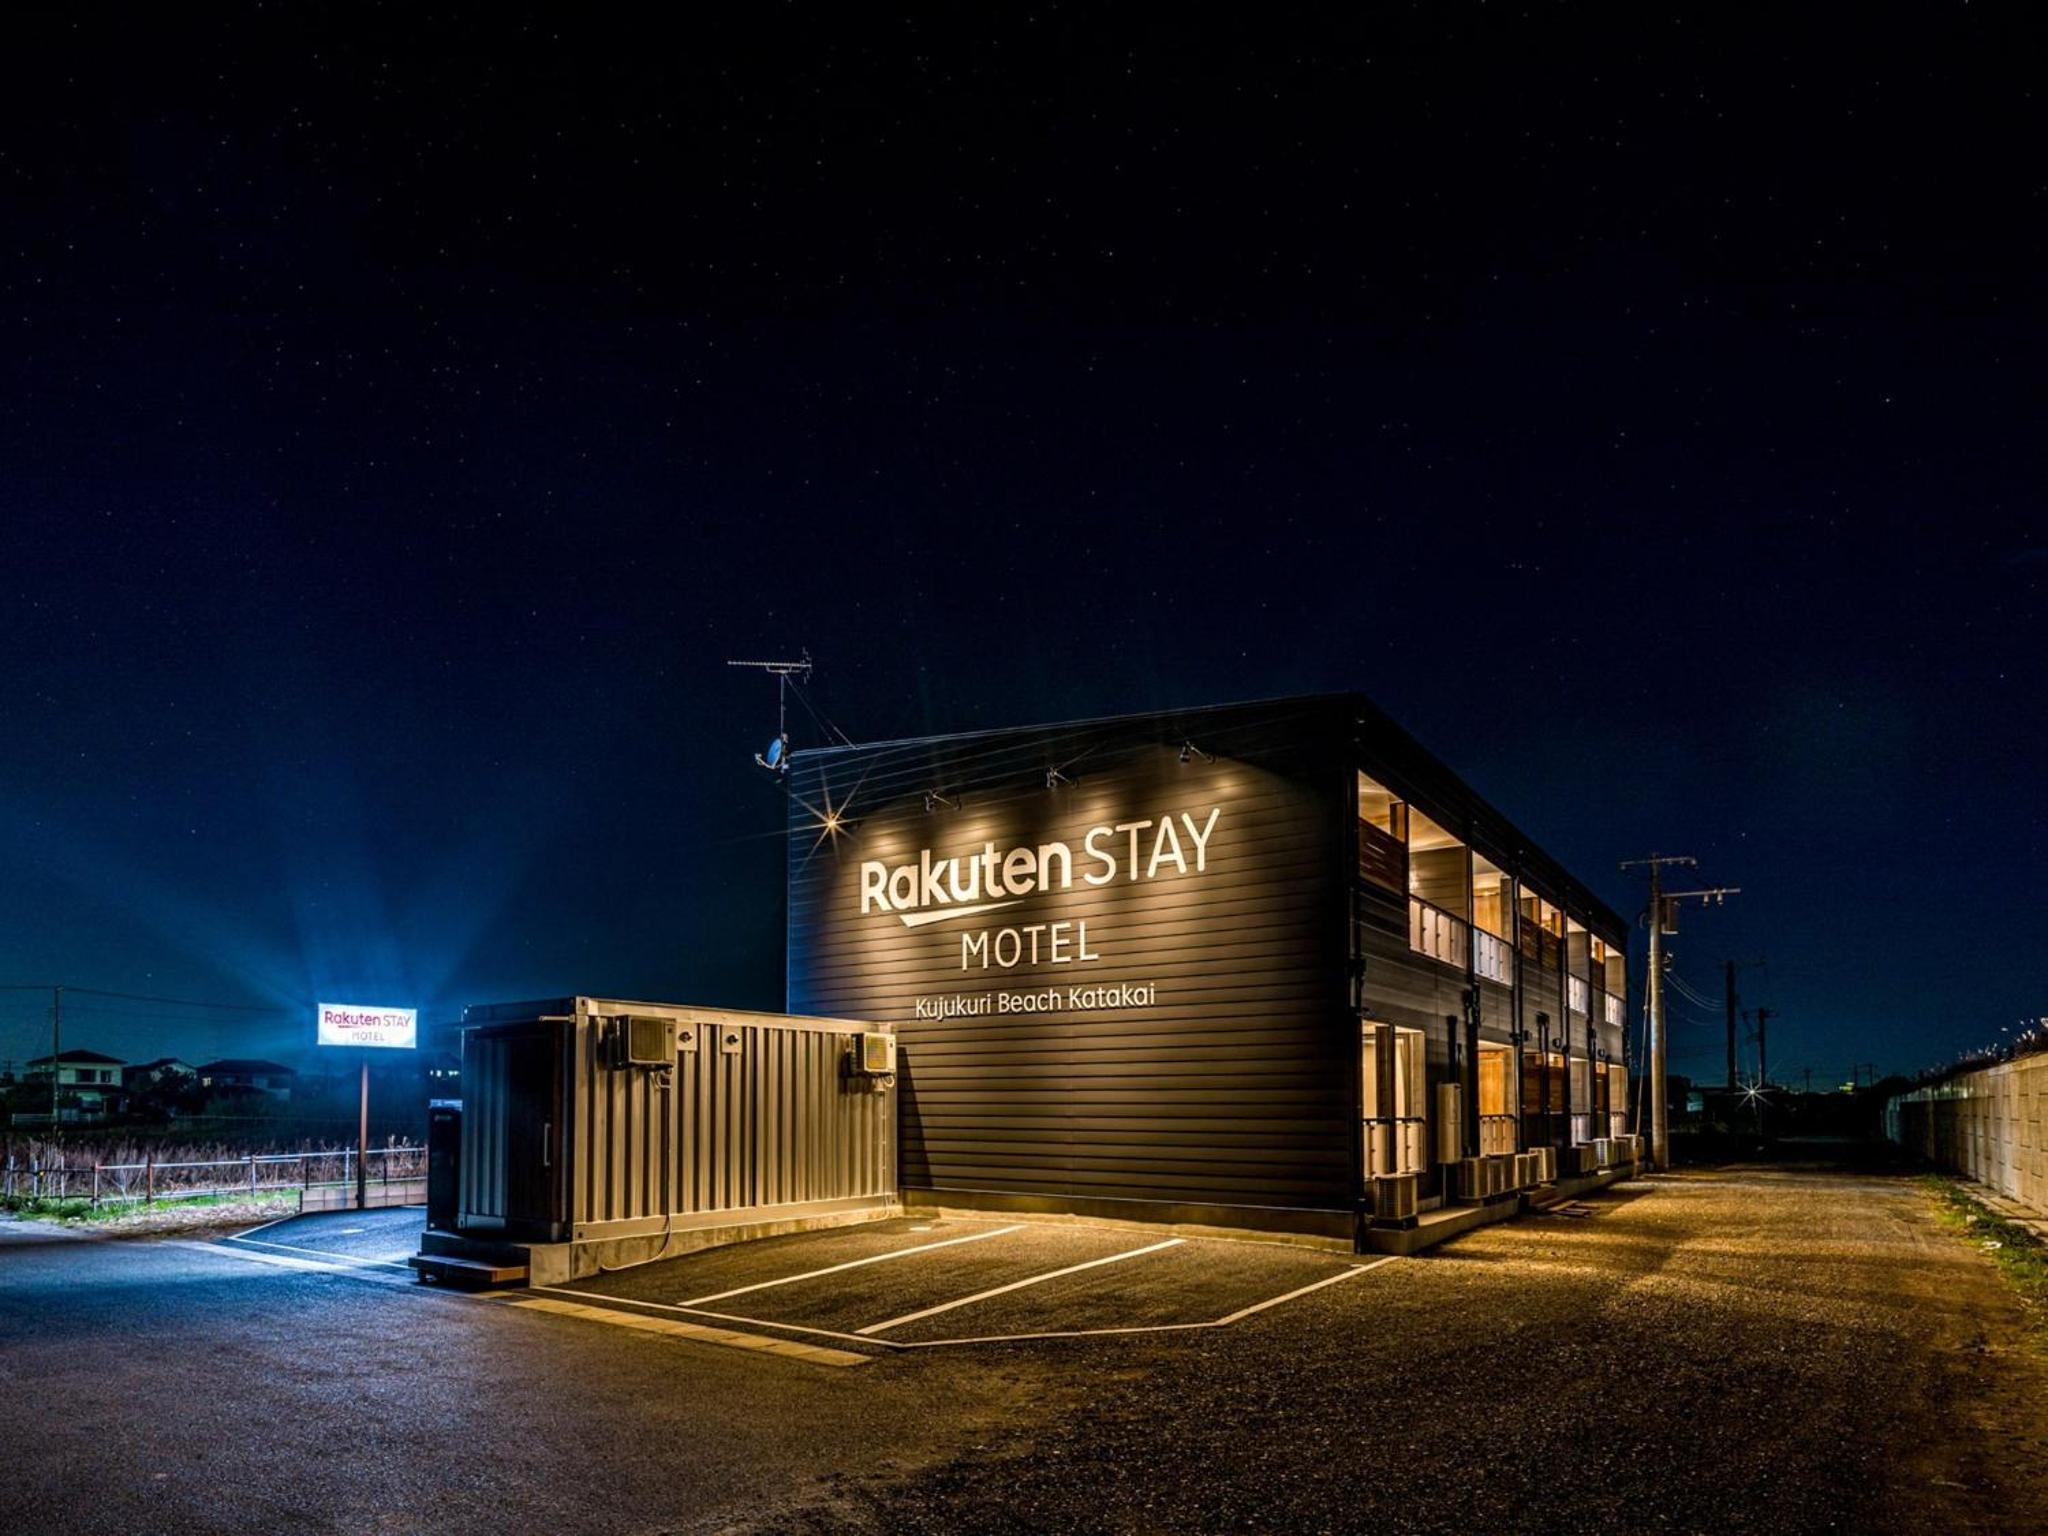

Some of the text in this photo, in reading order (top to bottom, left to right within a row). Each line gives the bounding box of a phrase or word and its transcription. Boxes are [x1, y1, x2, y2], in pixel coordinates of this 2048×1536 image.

[860, 808, 1221, 914] Rakuten STAY
[961, 921, 1099, 971] MOTEL
[324, 1010, 412, 1027] Rakuten STAY
[915, 982, 1155, 1023] Kujukuri Beach Katakai
[351, 1031, 384, 1041] MOTEL
